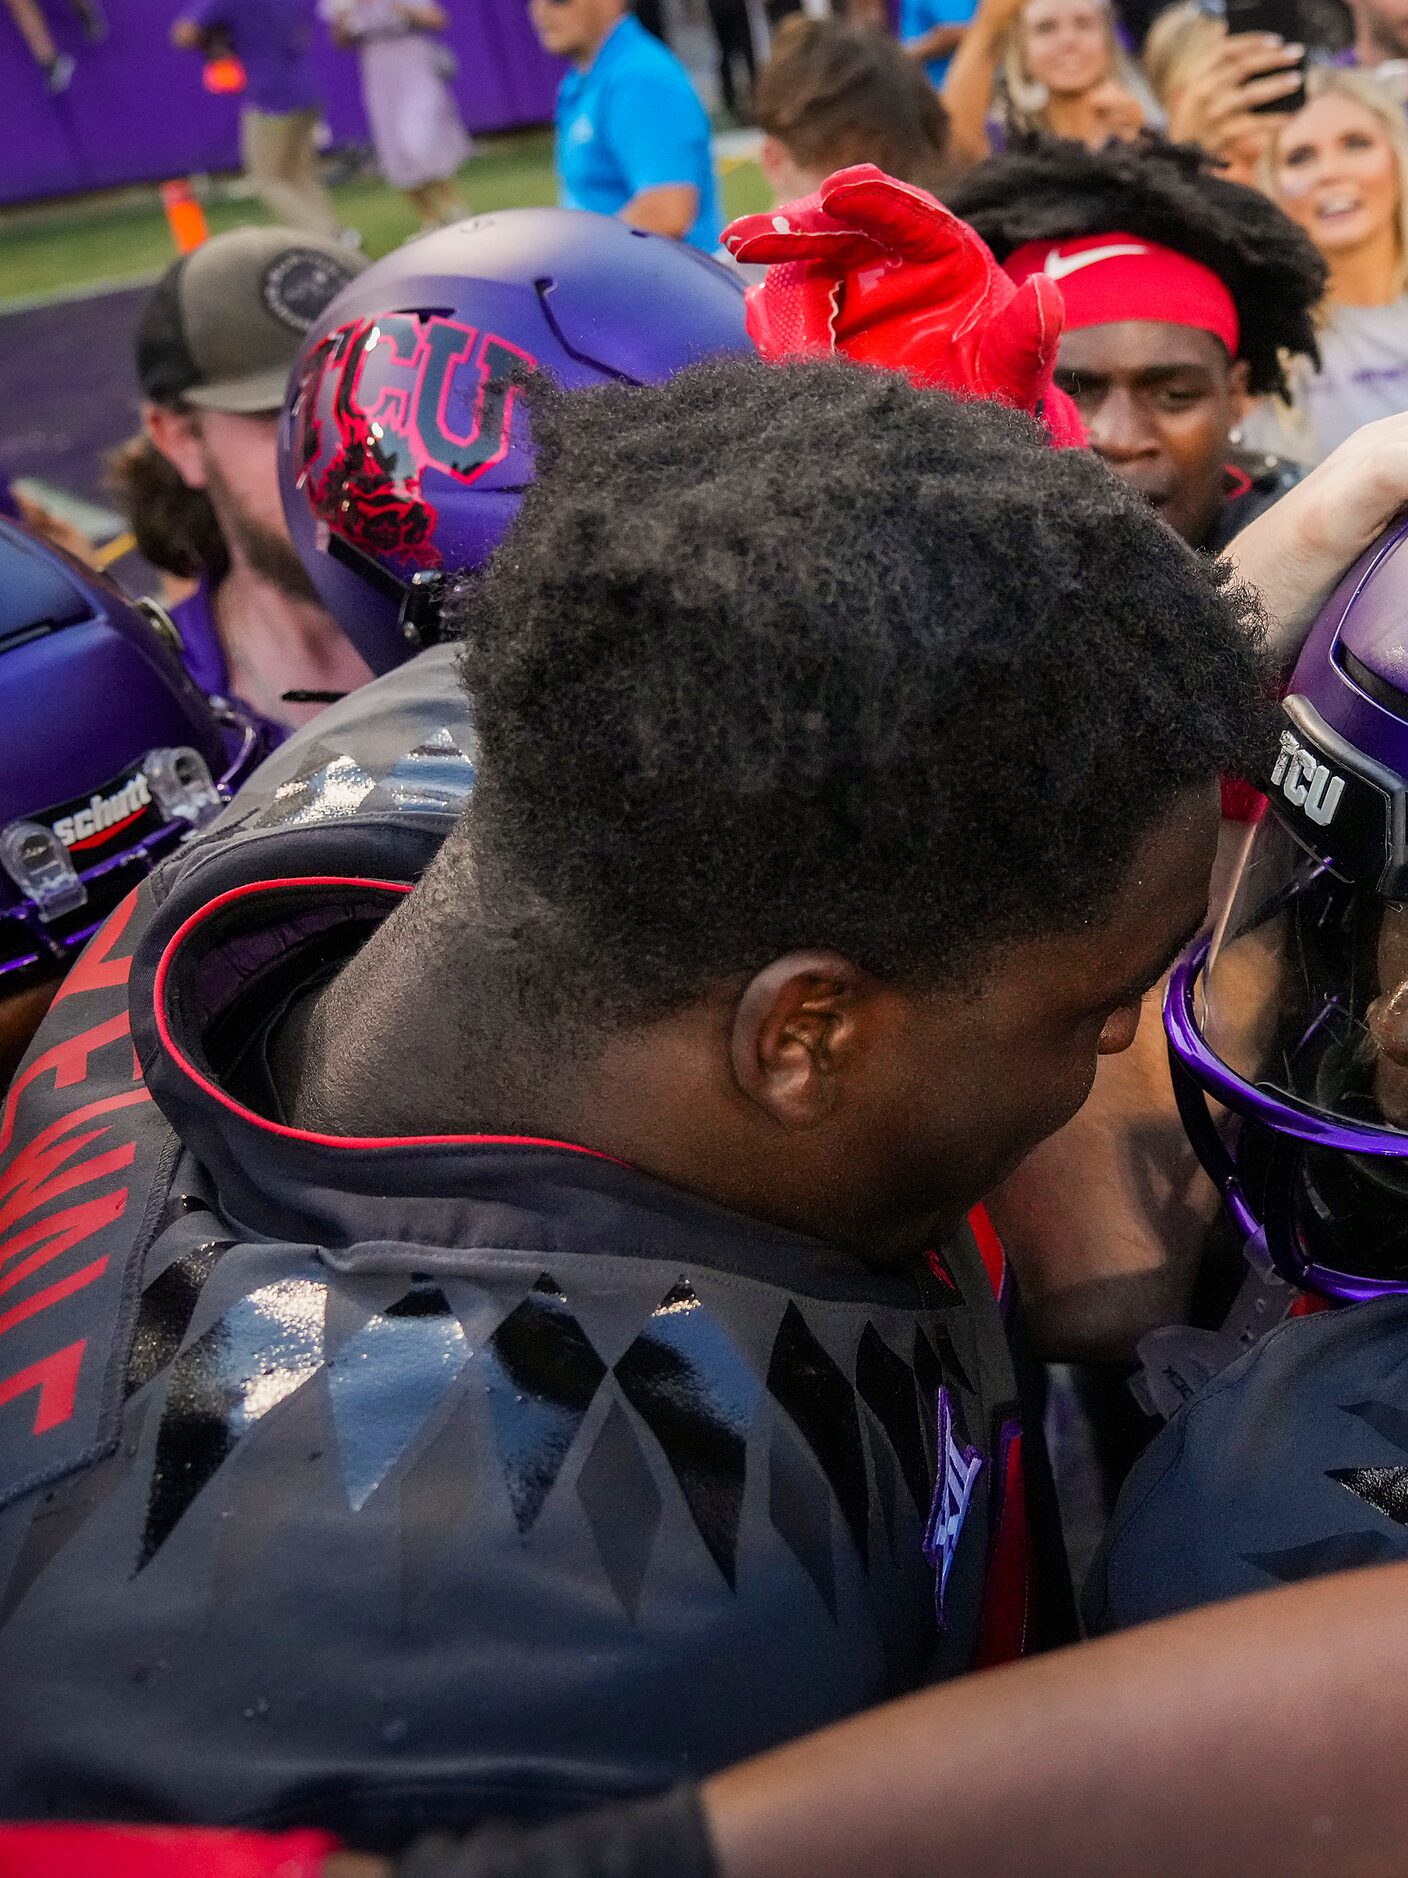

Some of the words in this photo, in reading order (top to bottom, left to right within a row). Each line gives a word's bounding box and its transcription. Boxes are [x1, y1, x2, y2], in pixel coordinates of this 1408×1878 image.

[298, 313, 541, 486] TCU
[53, 771, 152, 847] schutt
[1270, 730, 1346, 826] TCU
